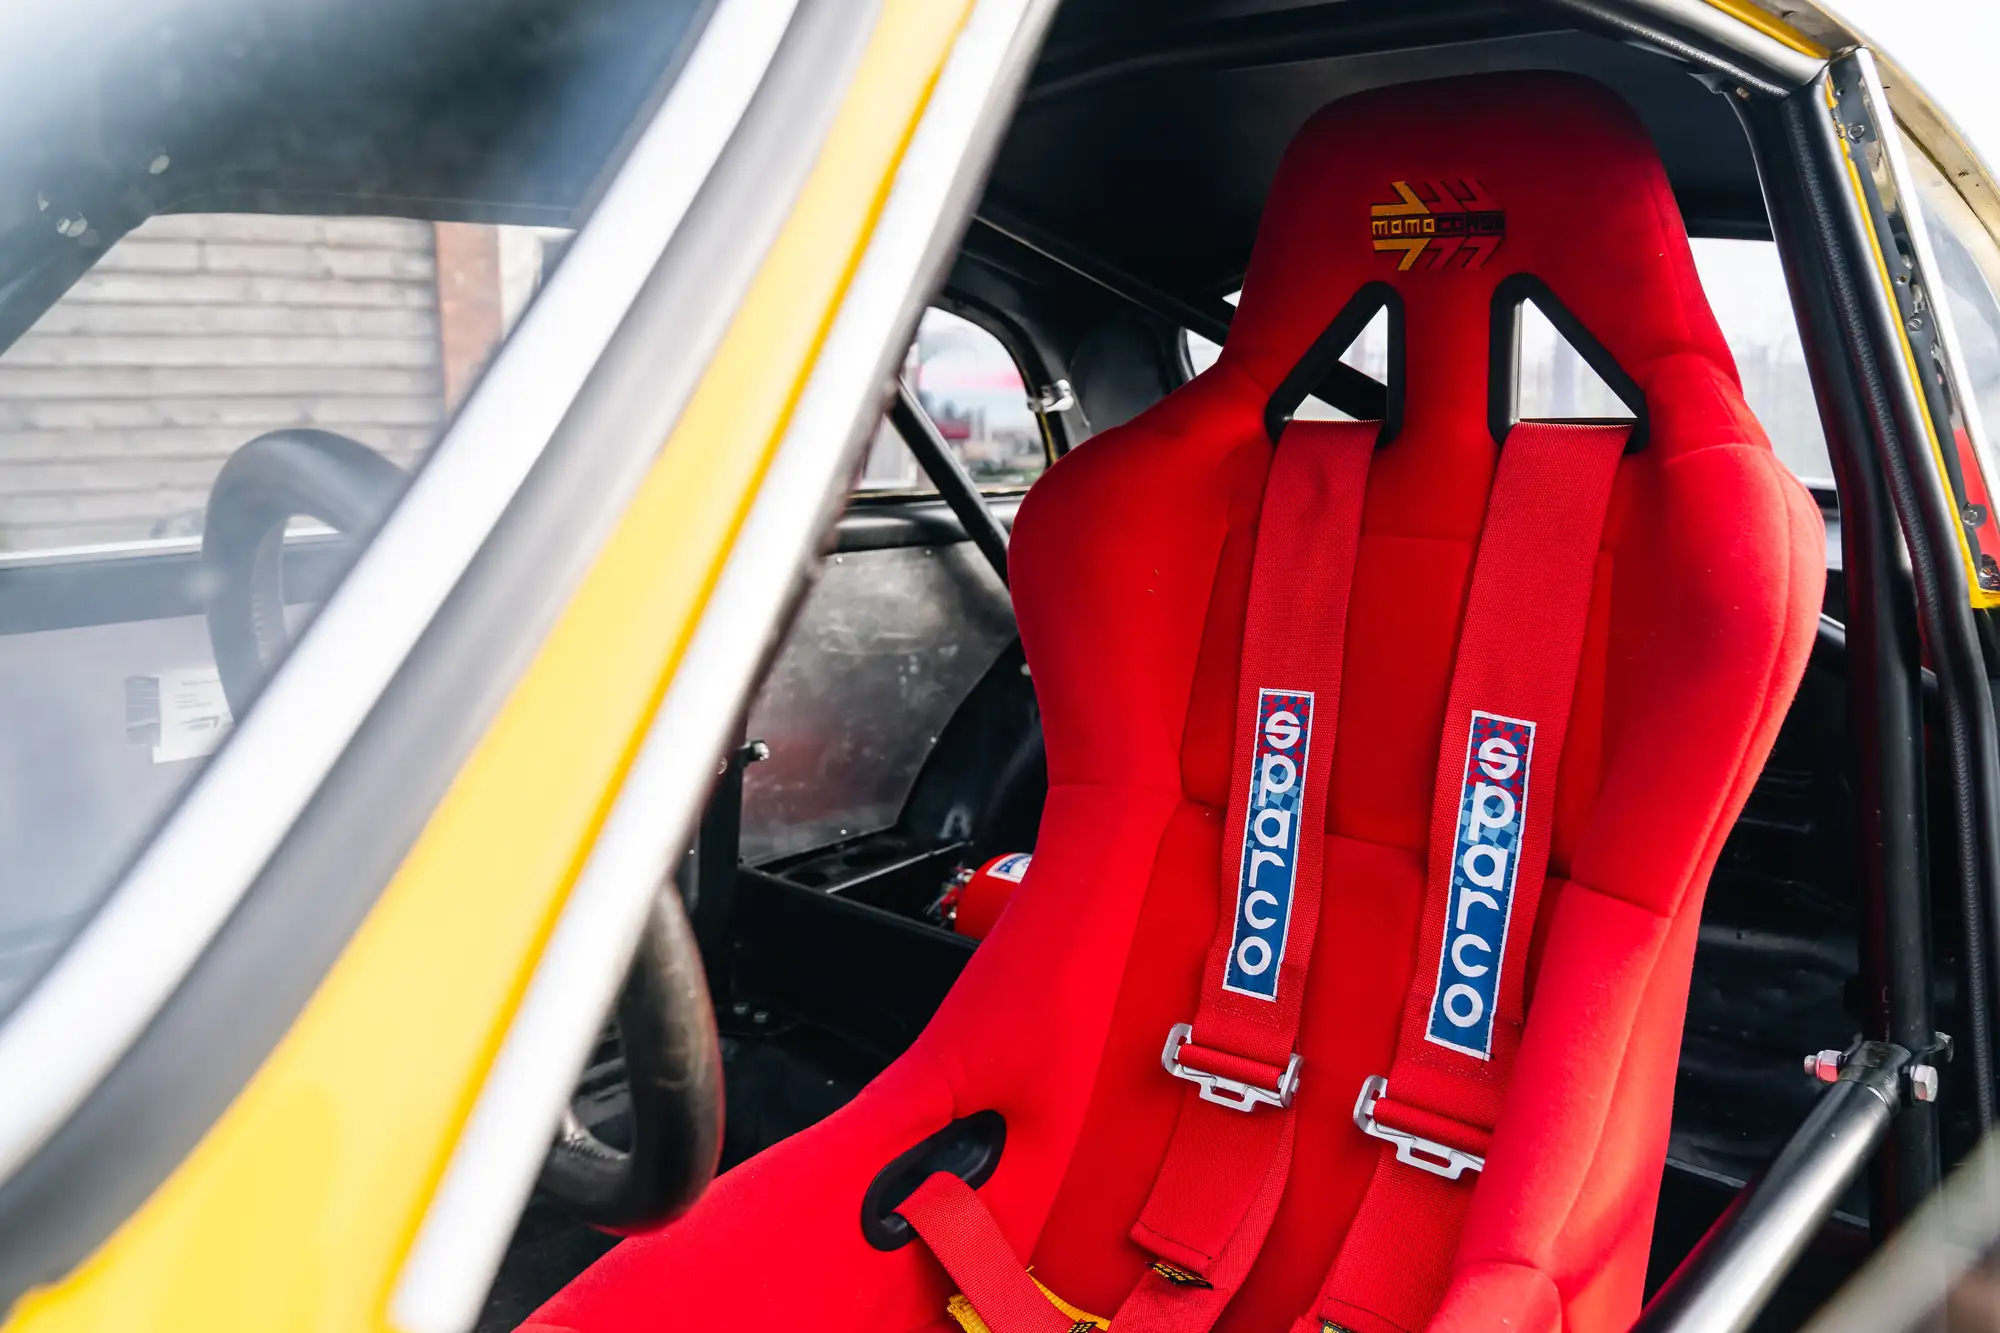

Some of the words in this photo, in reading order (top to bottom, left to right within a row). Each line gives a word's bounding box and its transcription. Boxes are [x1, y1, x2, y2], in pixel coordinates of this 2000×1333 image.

[1372, 218, 1435, 235] MOMO
[1236, 710, 1300, 976] sparco
[1442, 737, 1519, 1028] sparco
